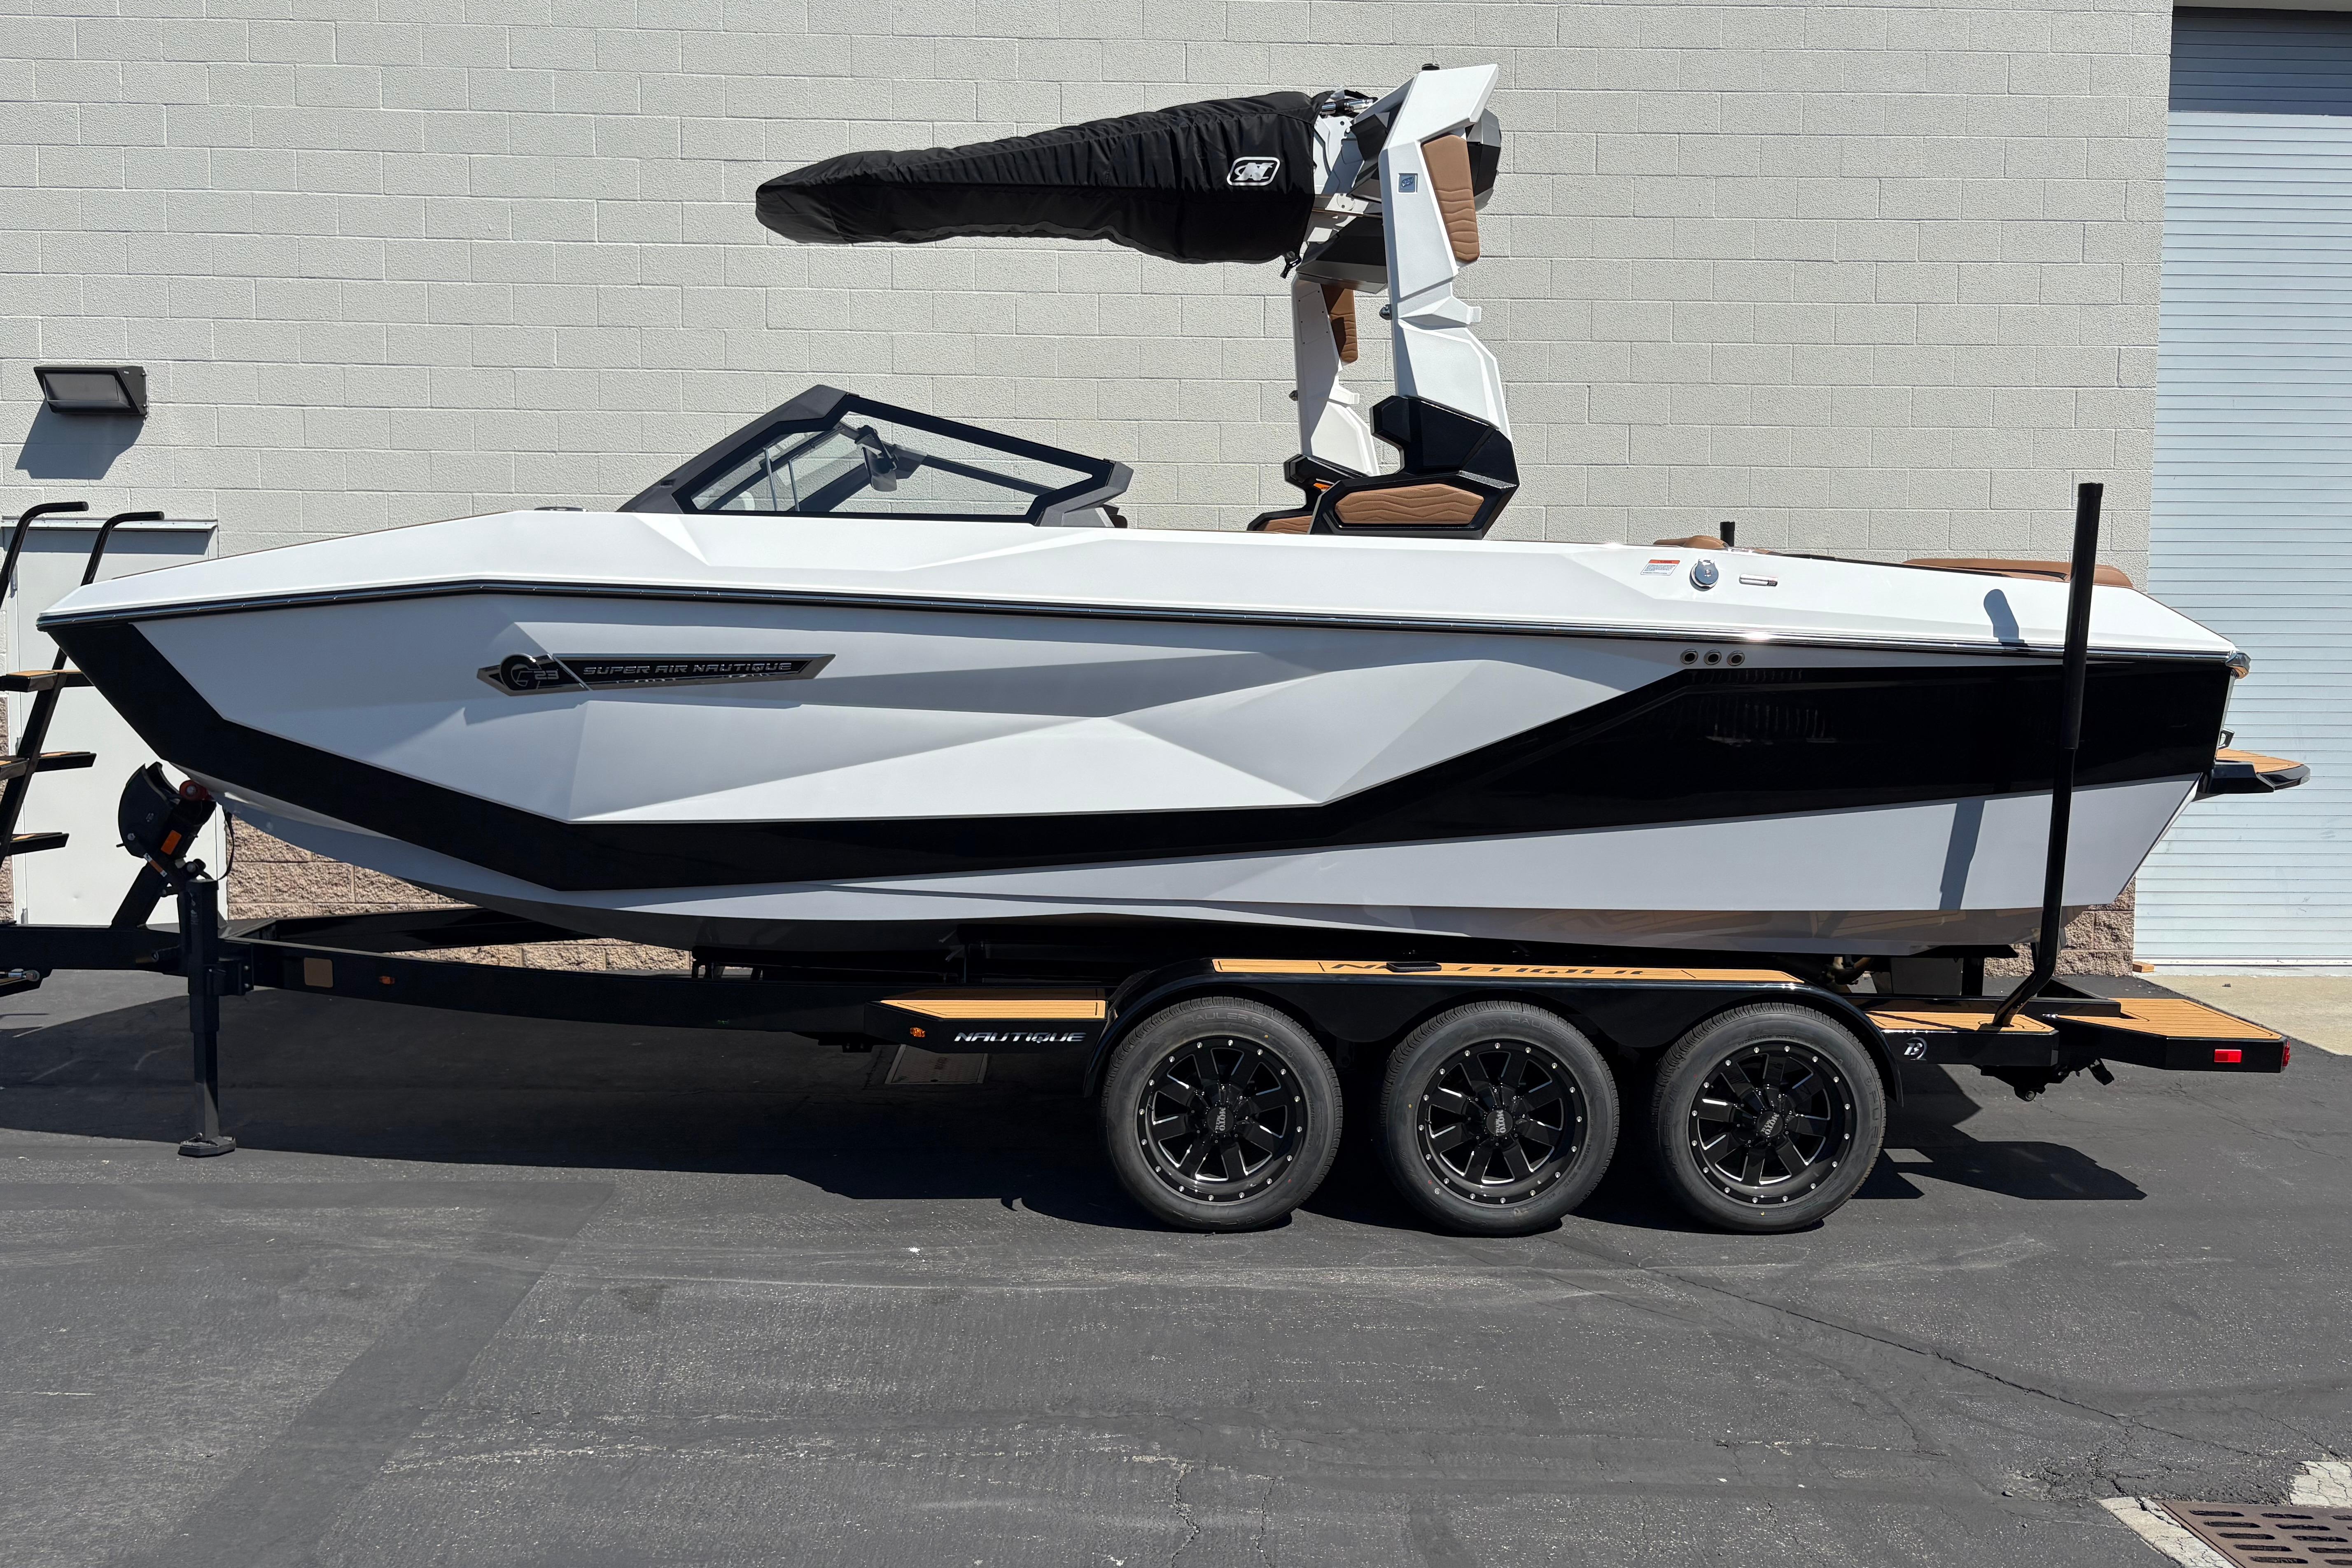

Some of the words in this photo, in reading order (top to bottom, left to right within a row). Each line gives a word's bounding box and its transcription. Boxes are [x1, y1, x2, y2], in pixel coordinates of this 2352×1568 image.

[583, 665, 651, 675] SUPER
[655, 665, 688, 673] AIR
[693, 663, 792, 672] NAUTIQUE
[1183, 1012, 1248, 1026] HAULER
[954, 1032, 1087, 1043] NAUTIQUE
[1496, 1109, 1506, 1134] MOTO
[1764, 1112, 1780, 1135] MOTO
